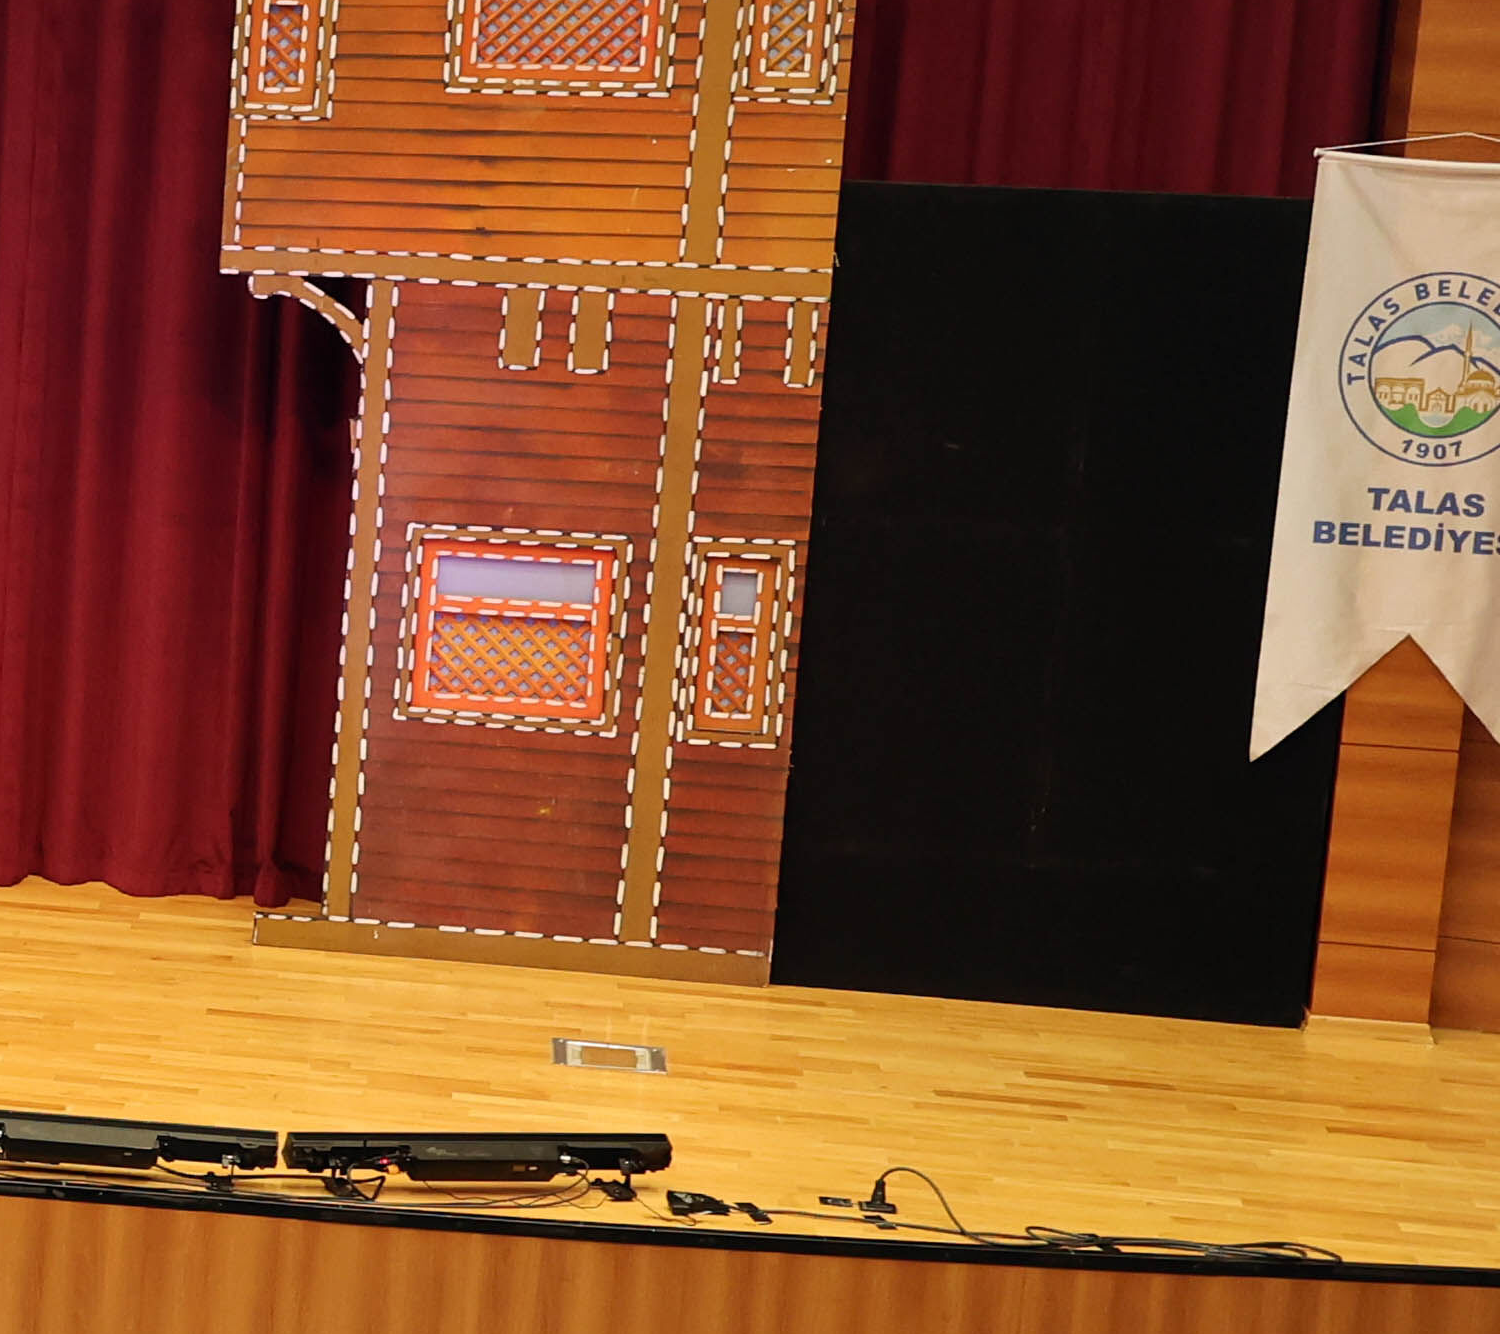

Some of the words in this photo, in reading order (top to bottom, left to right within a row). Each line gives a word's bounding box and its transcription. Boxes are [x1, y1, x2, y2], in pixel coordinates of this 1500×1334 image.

[1347, 297, 1401, 386] TALAS
[1401, 439, 1462, 459] 1907
[1367, 487, 1485, 518] TALAS
[1312, 520, 1500, 556] BELEDİYE
